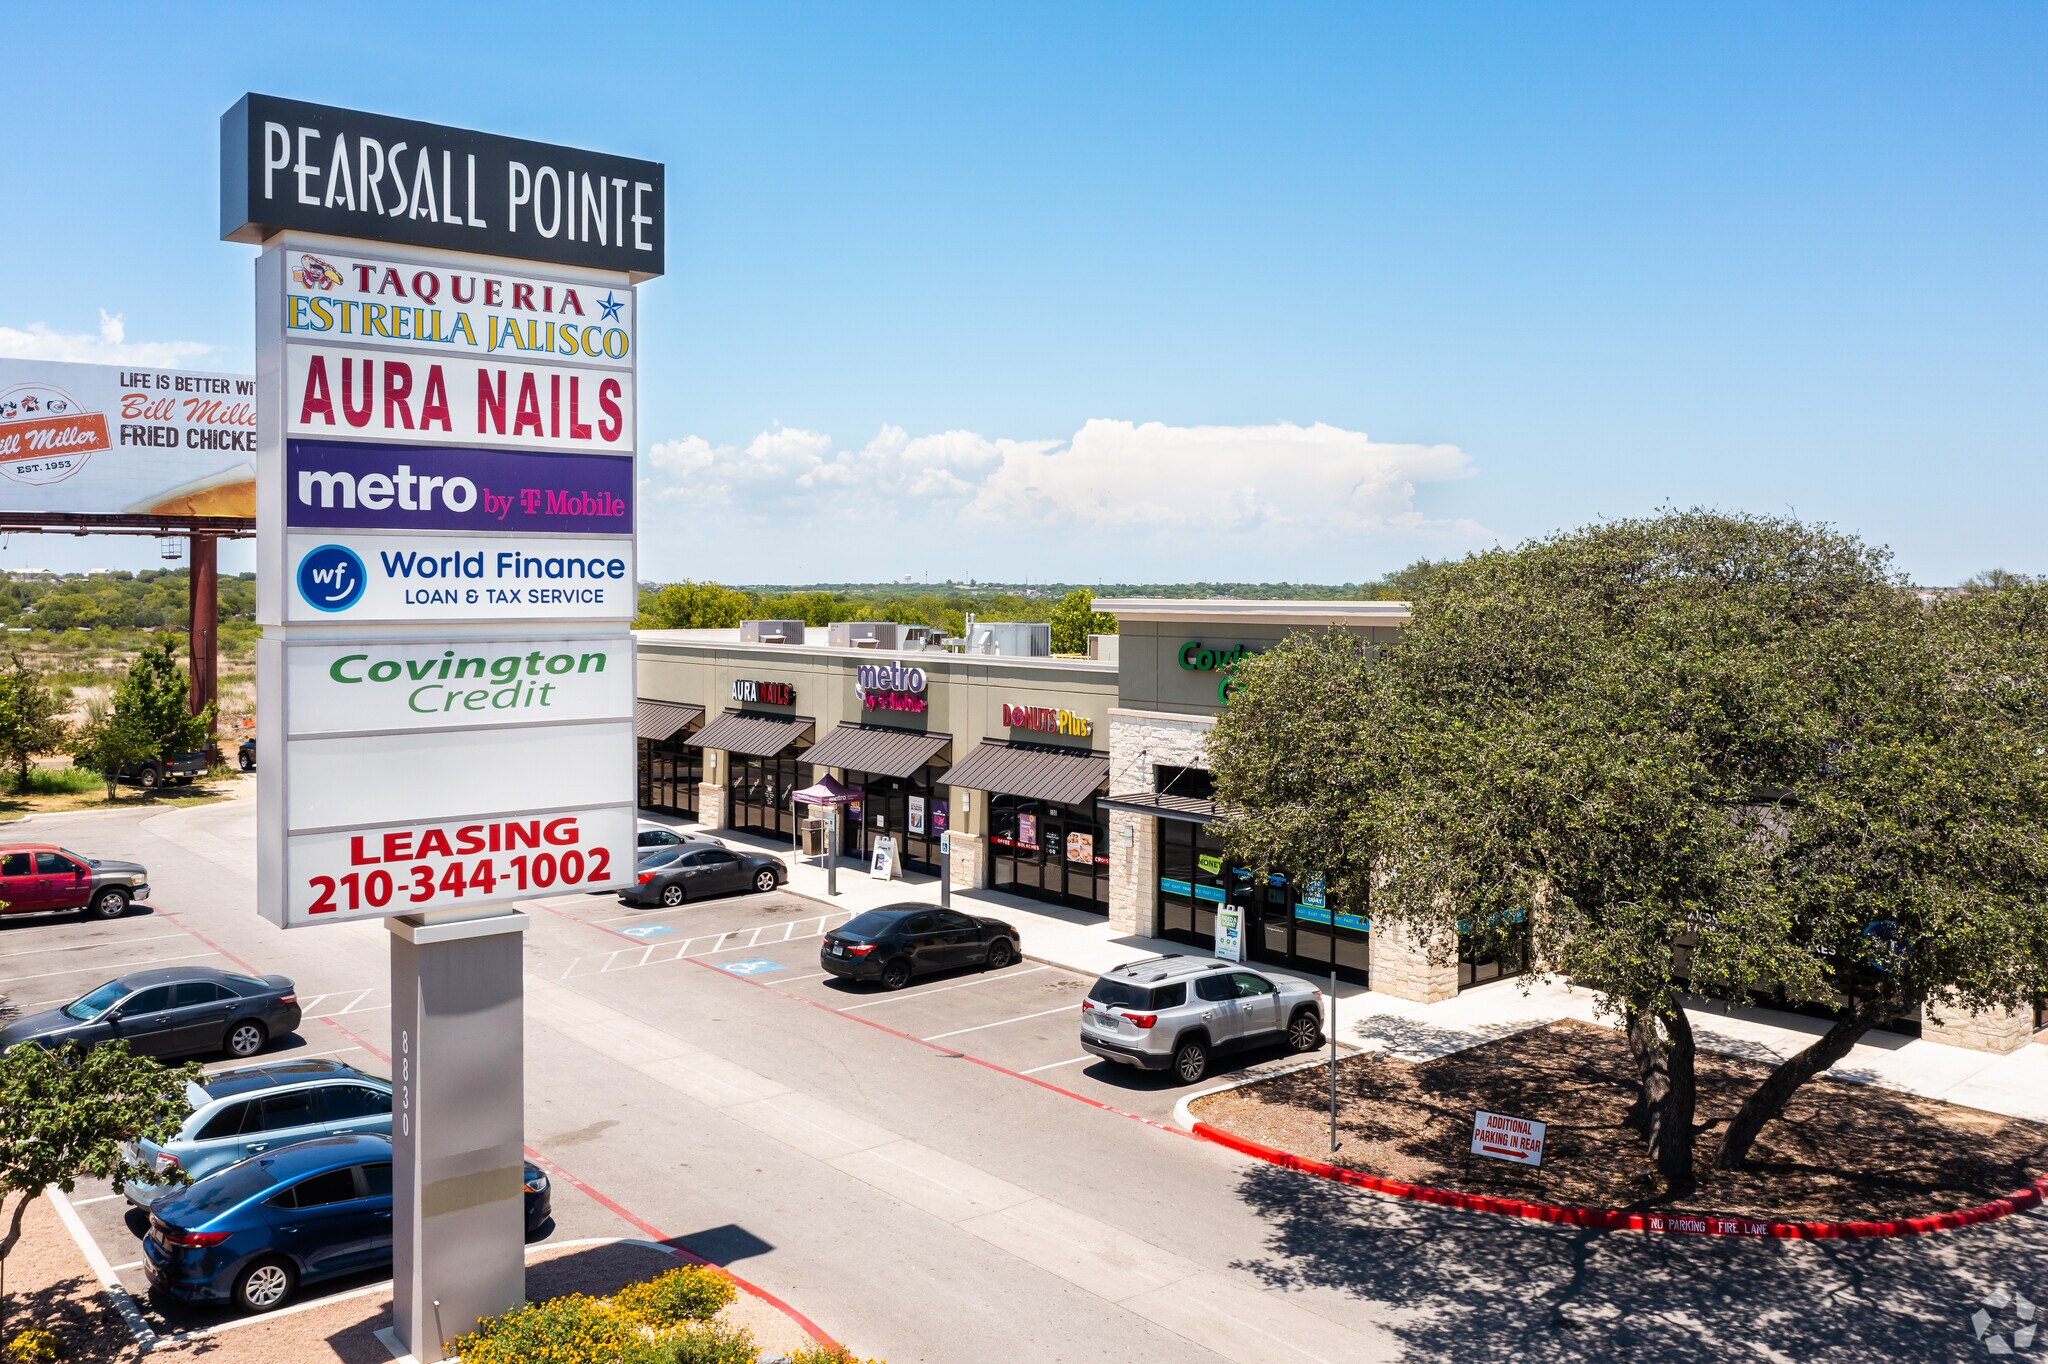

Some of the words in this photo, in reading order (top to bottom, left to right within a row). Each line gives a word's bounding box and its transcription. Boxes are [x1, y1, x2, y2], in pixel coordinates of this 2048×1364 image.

[264, 121, 487, 229] PEARSALL
[508, 160, 653, 252] POINTE
[352, 263, 585, 317] TAQUERIA
[286, 294, 478, 346] ESTRELLA
[487, 315, 630, 360] JALISCO
[120, 372, 151, 388] LIFE
[156, 374, 170, 390] IS
[175, 376, 230, 394] BETTER
[300, 354, 453, 433] AURA
[477, 368, 624, 443] NAILS
[121, 393, 176, 421] Bill
[0, 433, 21, 455] ill
[24, 426, 97, 450] Miller
[120, 424, 179, 448] FRIED
[186, 428, 256, 452] CHICKE
[17, 464, 43, 474] EST.
[45, 460, 72, 470] 1953
[297, 465, 478, 513] metro
[483, 488, 515, 520] by
[380, 551, 483, 578] World
[497, 551, 625, 579] Finance
[405, 589, 458, 605] LOAN
[465, 589, 479, 605] &
[486, 589, 521, 604] TAX
[528, 589, 604, 604] SERVICE
[329, 650, 607, 685] Covington
[855, 660, 926, 699] metro
[408, 680, 556, 714] Credit
[732, 680, 757, 702] AURA
[760, 683, 790, 705] NAILS
[1003, 704, 1057, 734] DONUTS
[1059, 709, 1087, 737] Plus
[350, 817, 580, 867] LEASING
[308, 847, 611, 915] 210-344-1002
[1474, 1128, 1508, 1146] PARKING
[1510, 1135, 1519, 1148] IN
[1520, 1137, 1541, 1152] REAR
[1486, 1115, 1532, 1135] ADDITIONAL
[1651, 1218, 1664, 1229] NO
[1668, 1219, 1706, 1232] PARKING
[1718, 1221, 1739, 1234] FIRE
[1744, 1223, 1768, 1235] LANE
